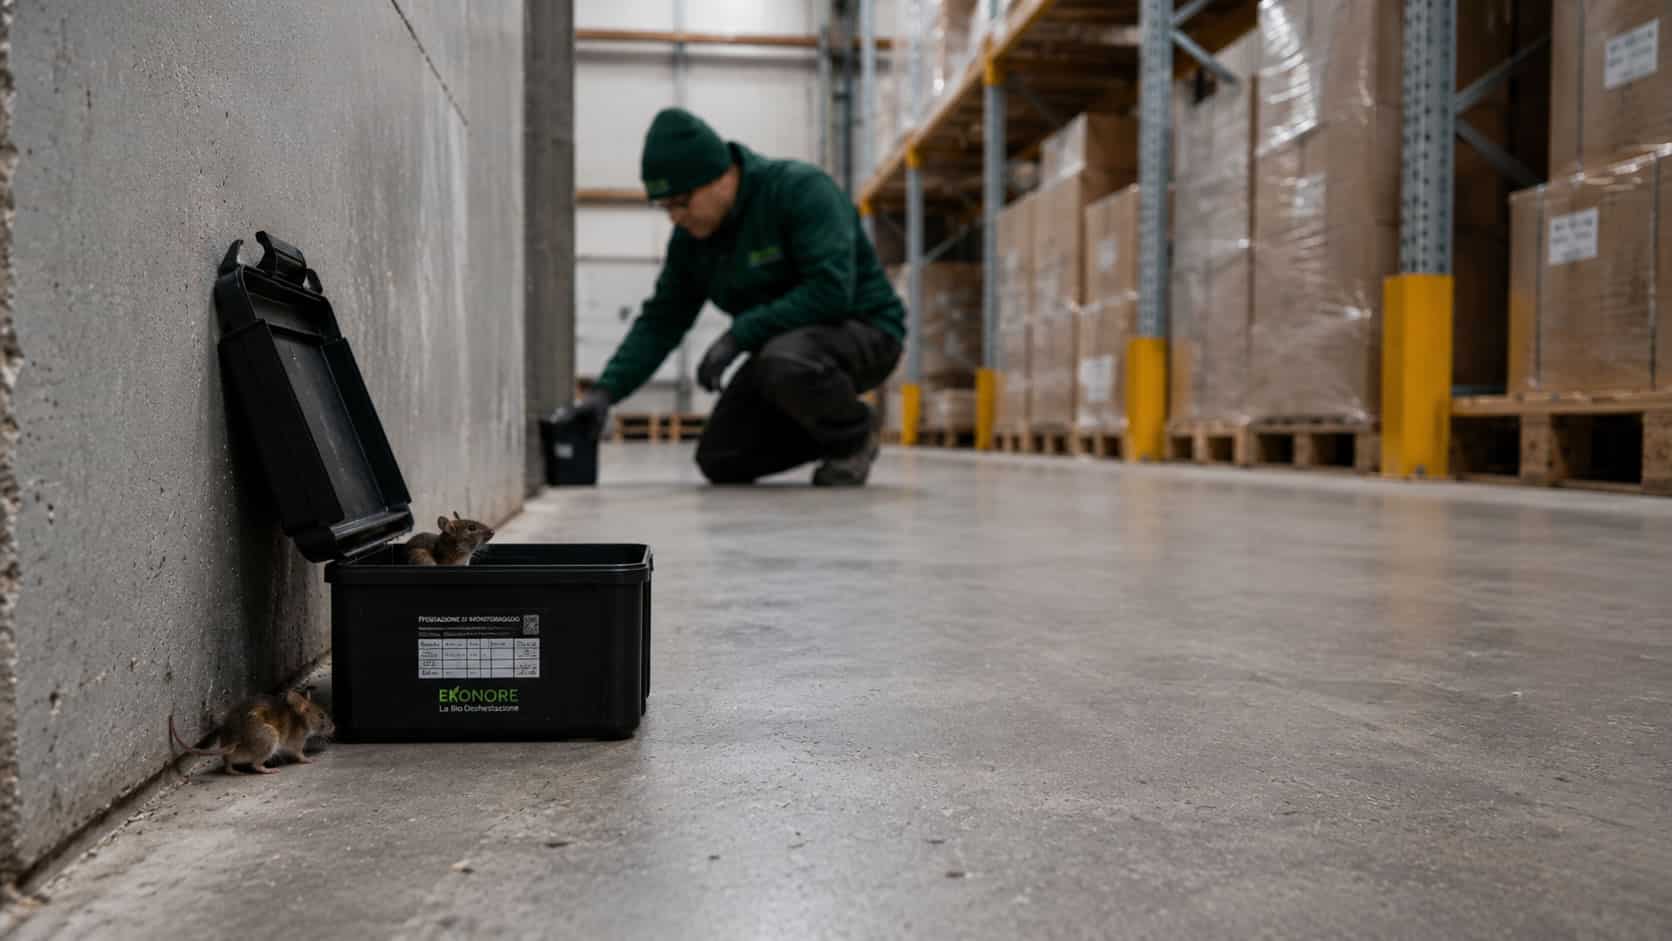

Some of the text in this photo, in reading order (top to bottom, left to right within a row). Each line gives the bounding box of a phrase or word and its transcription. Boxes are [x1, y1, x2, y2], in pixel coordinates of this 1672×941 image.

[439, 686, 519, 702] EKONORE
[440, 704, 449, 712] La
[451, 704, 463, 712] Bio
